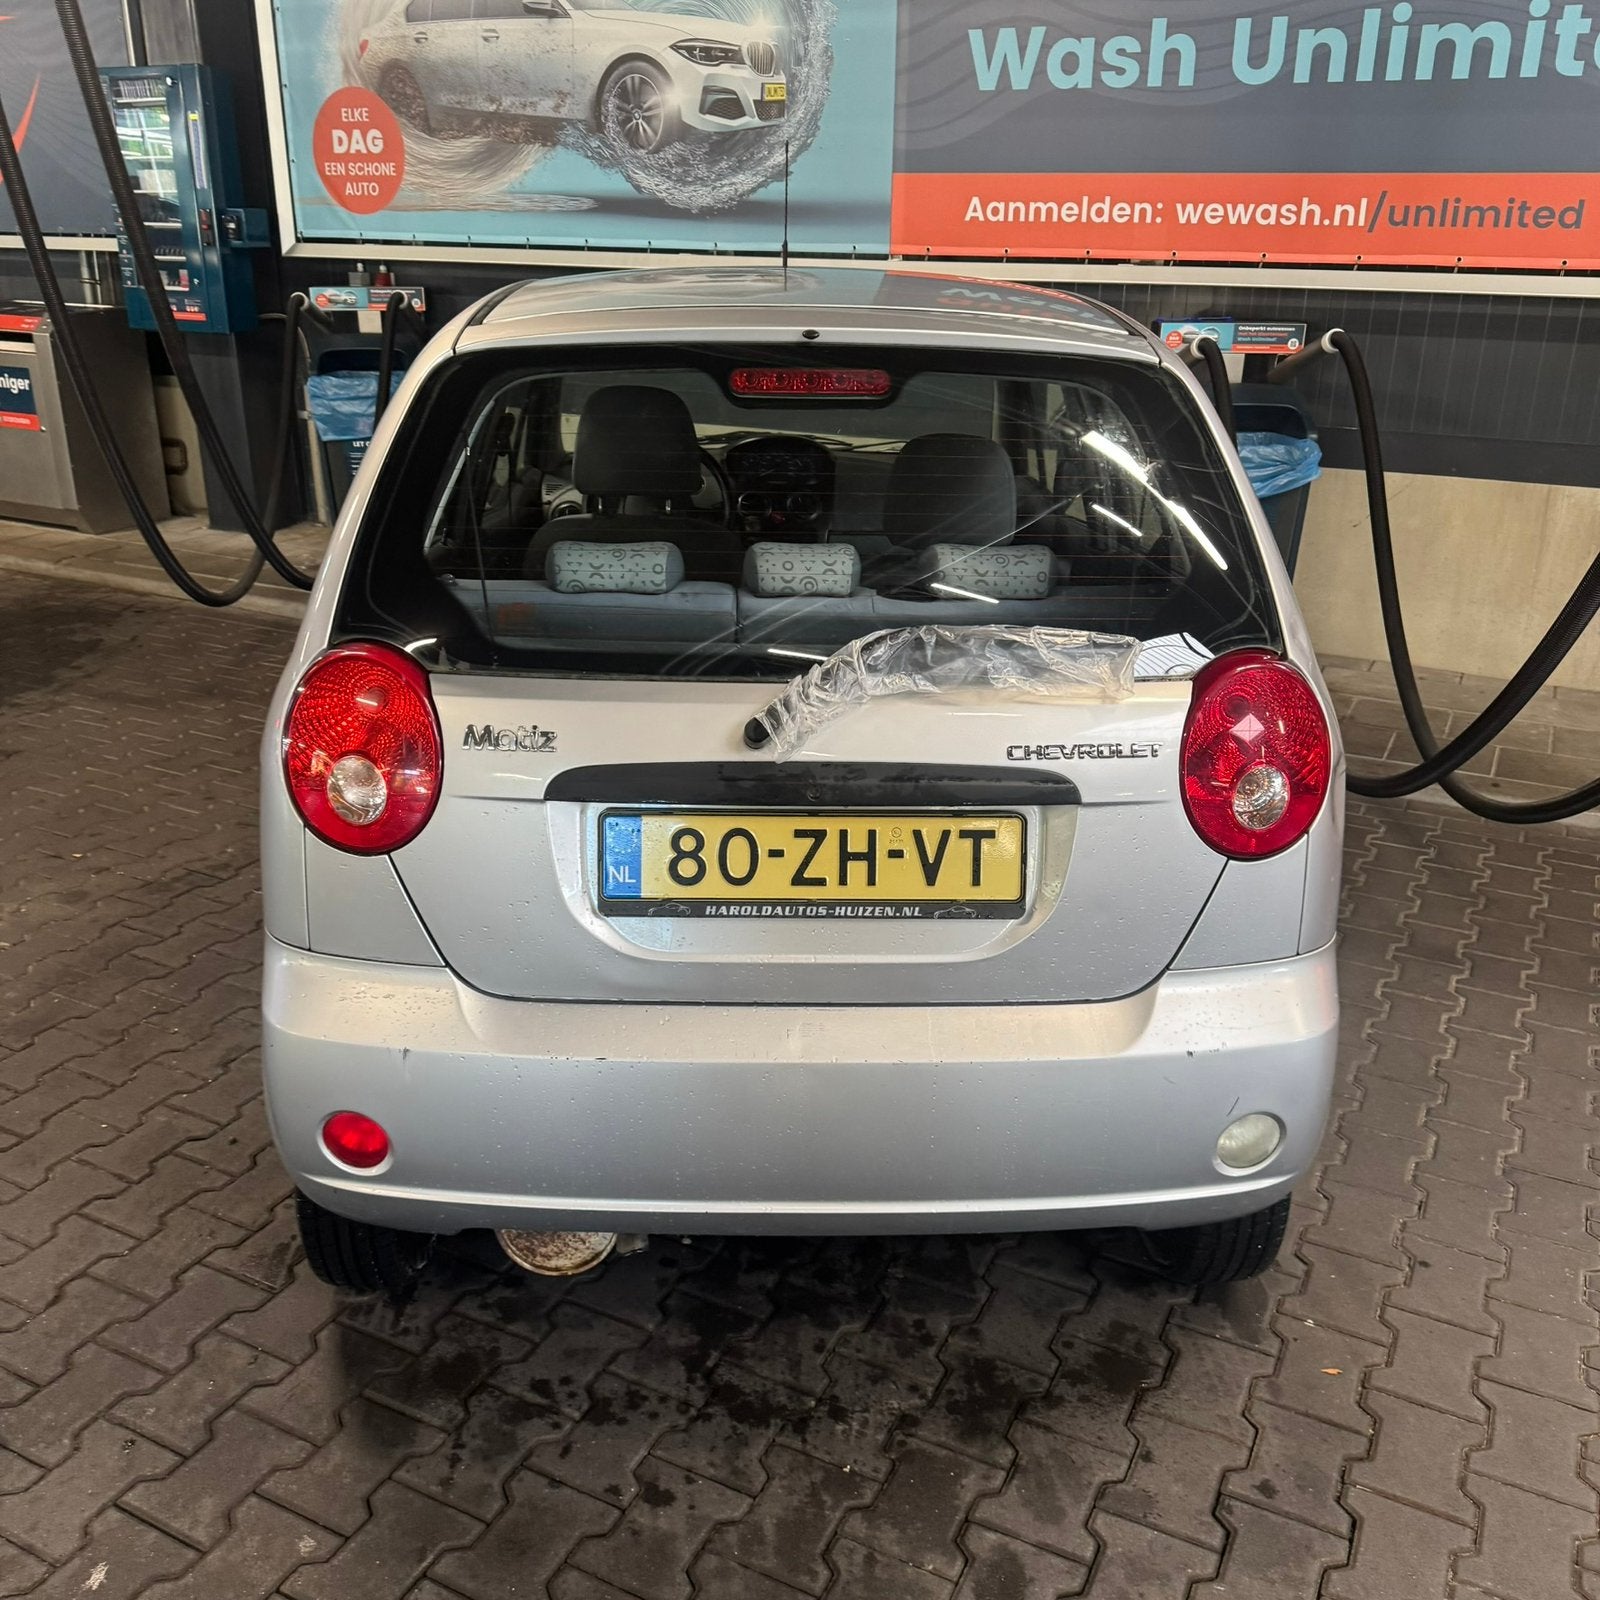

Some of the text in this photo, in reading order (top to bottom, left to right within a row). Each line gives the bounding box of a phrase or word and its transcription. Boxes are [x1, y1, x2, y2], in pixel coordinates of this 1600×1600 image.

[968, 0, 1600, 90] Wash Unlimit
[341, 107, 369, 122] ELKE
[331, 128, 384, 154] DAG
[324, 162, 396, 176] EEN SCHONE
[345, 182, 379, 196] AUTO
[964, 190, 1586, 234] Aanmelden: wewash.nl/unlimited
[462, 724, 558, 752] Matiz
[1006, 741, 1163, 760] CHEVROLET
[668, 827, 996, 887] 80-ZH-VT
[609, 865, 636, 883] NL
[705, 904, 922, 918] HAROLDAUTOS-HUIZEN.NL
